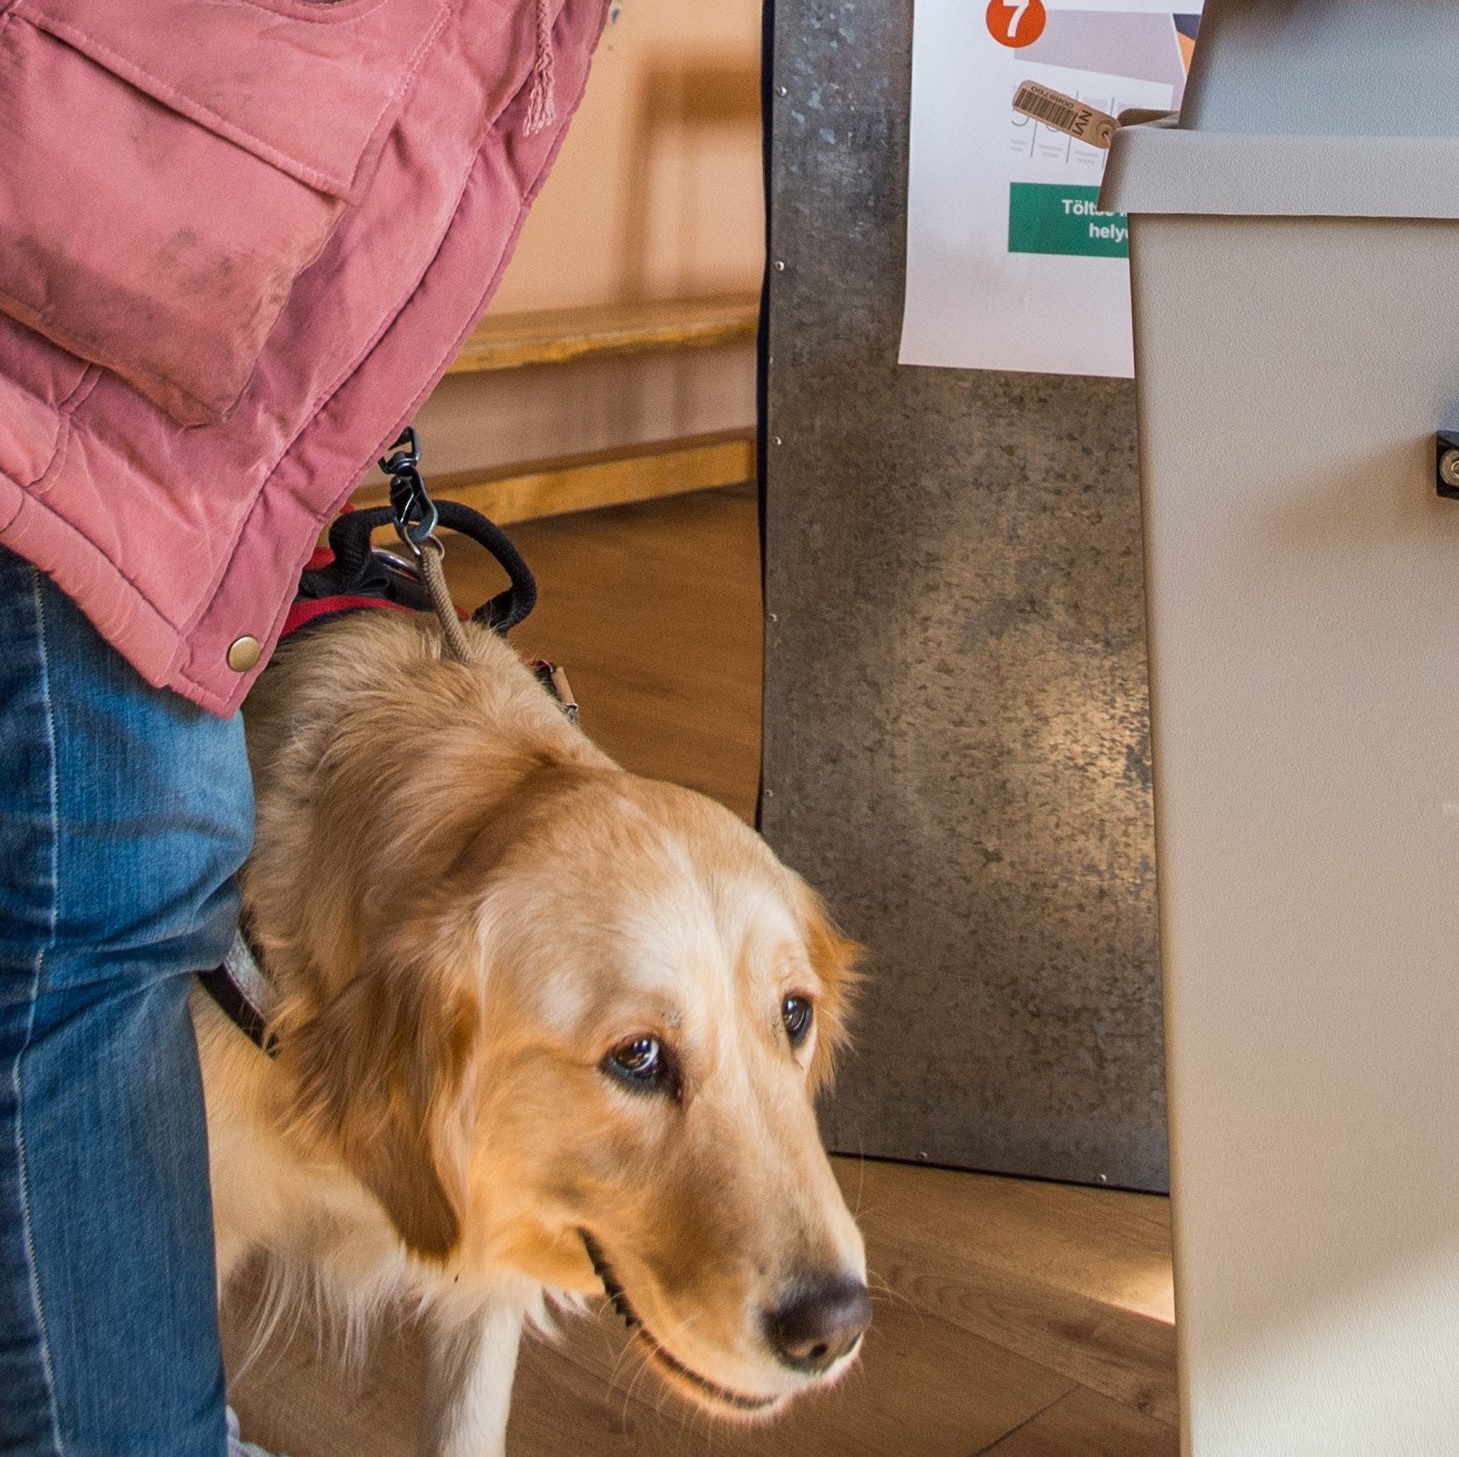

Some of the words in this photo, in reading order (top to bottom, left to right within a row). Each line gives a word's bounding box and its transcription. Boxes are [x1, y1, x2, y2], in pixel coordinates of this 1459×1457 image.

[1072, 109, 1093, 137] NVI
[1061, 199, 1115, 216] Tölt
[1089, 223, 1128, 242] hely
